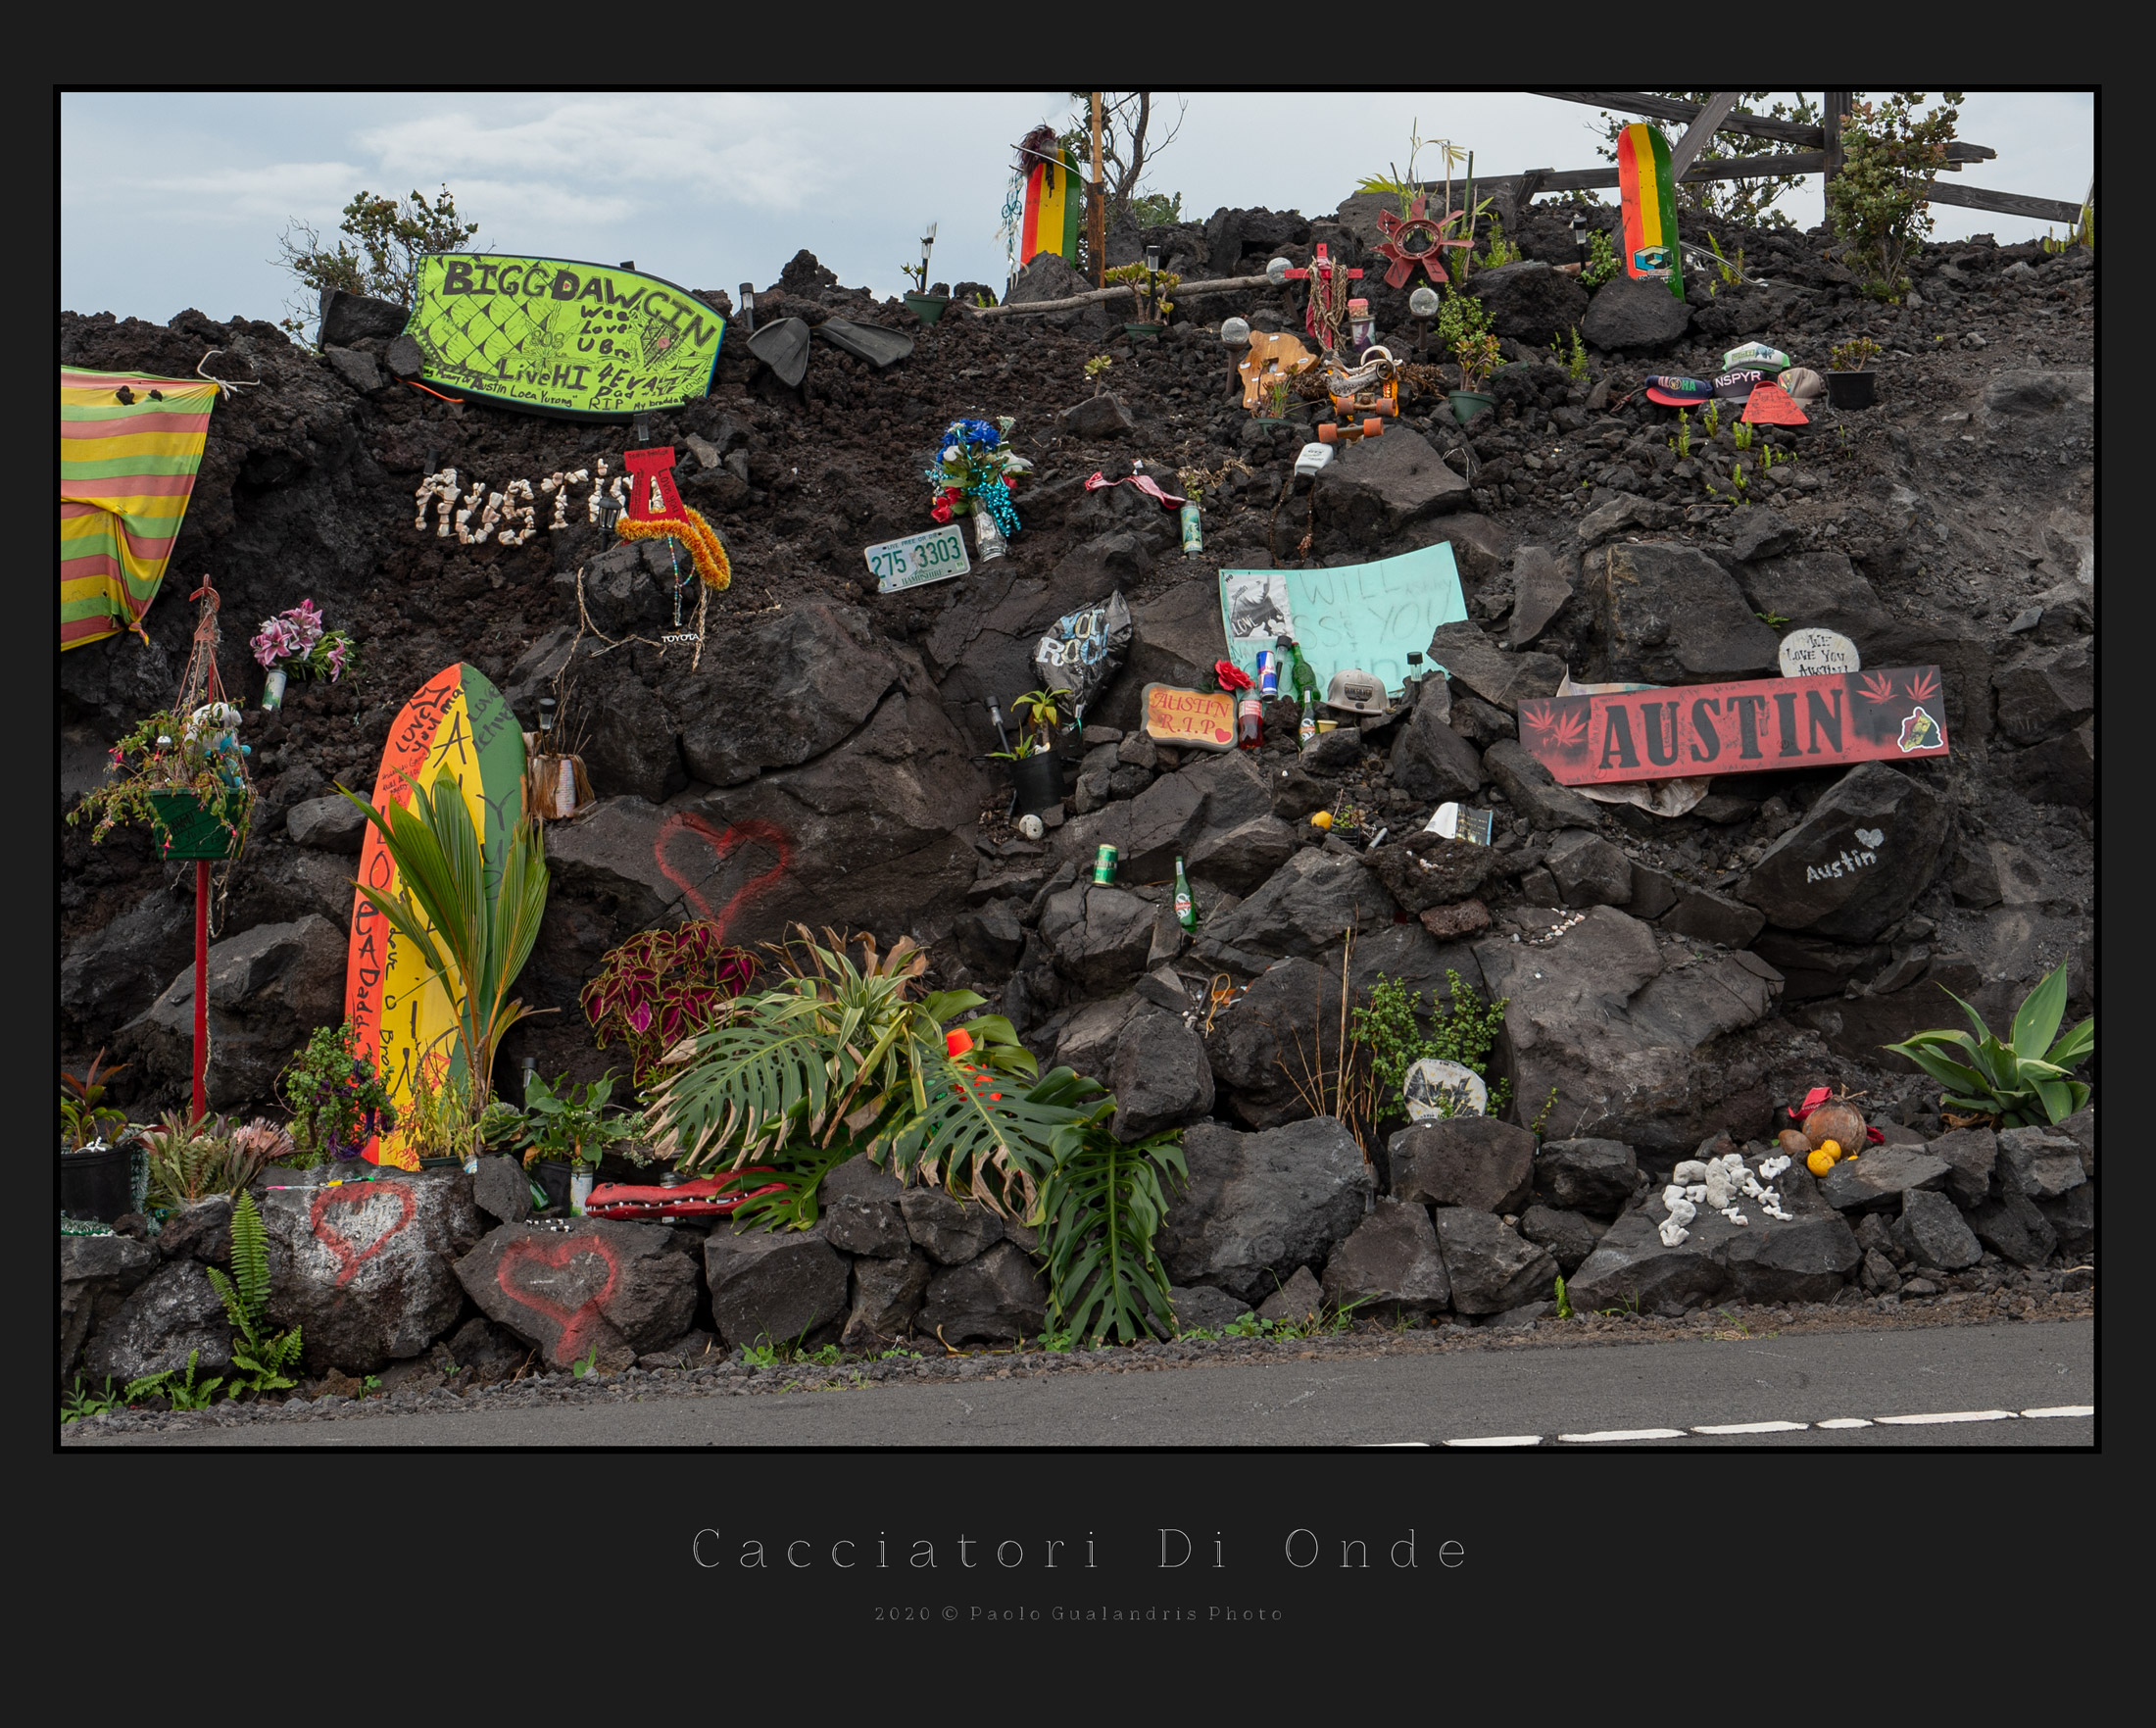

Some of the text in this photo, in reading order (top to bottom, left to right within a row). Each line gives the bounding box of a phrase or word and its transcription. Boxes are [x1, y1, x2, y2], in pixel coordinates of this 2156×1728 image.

[1715, 370, 1762, 389] NSPYR
[871, 535, 961, 579] 275 3303
[901, 568, 944, 586] HAMPSHIRE
[1231, 614, 1259, 637] LOVE
[661, 632, 701, 644] TOYOTA
[1806, 634, 1833, 648] WE
[1786, 648, 1845, 663] LOVE YOU
[1151, 691, 1230, 718] AUSTIN
[1599, 689, 1844, 770] AUSTIN
[1806, 849, 1878, 884] Austin
